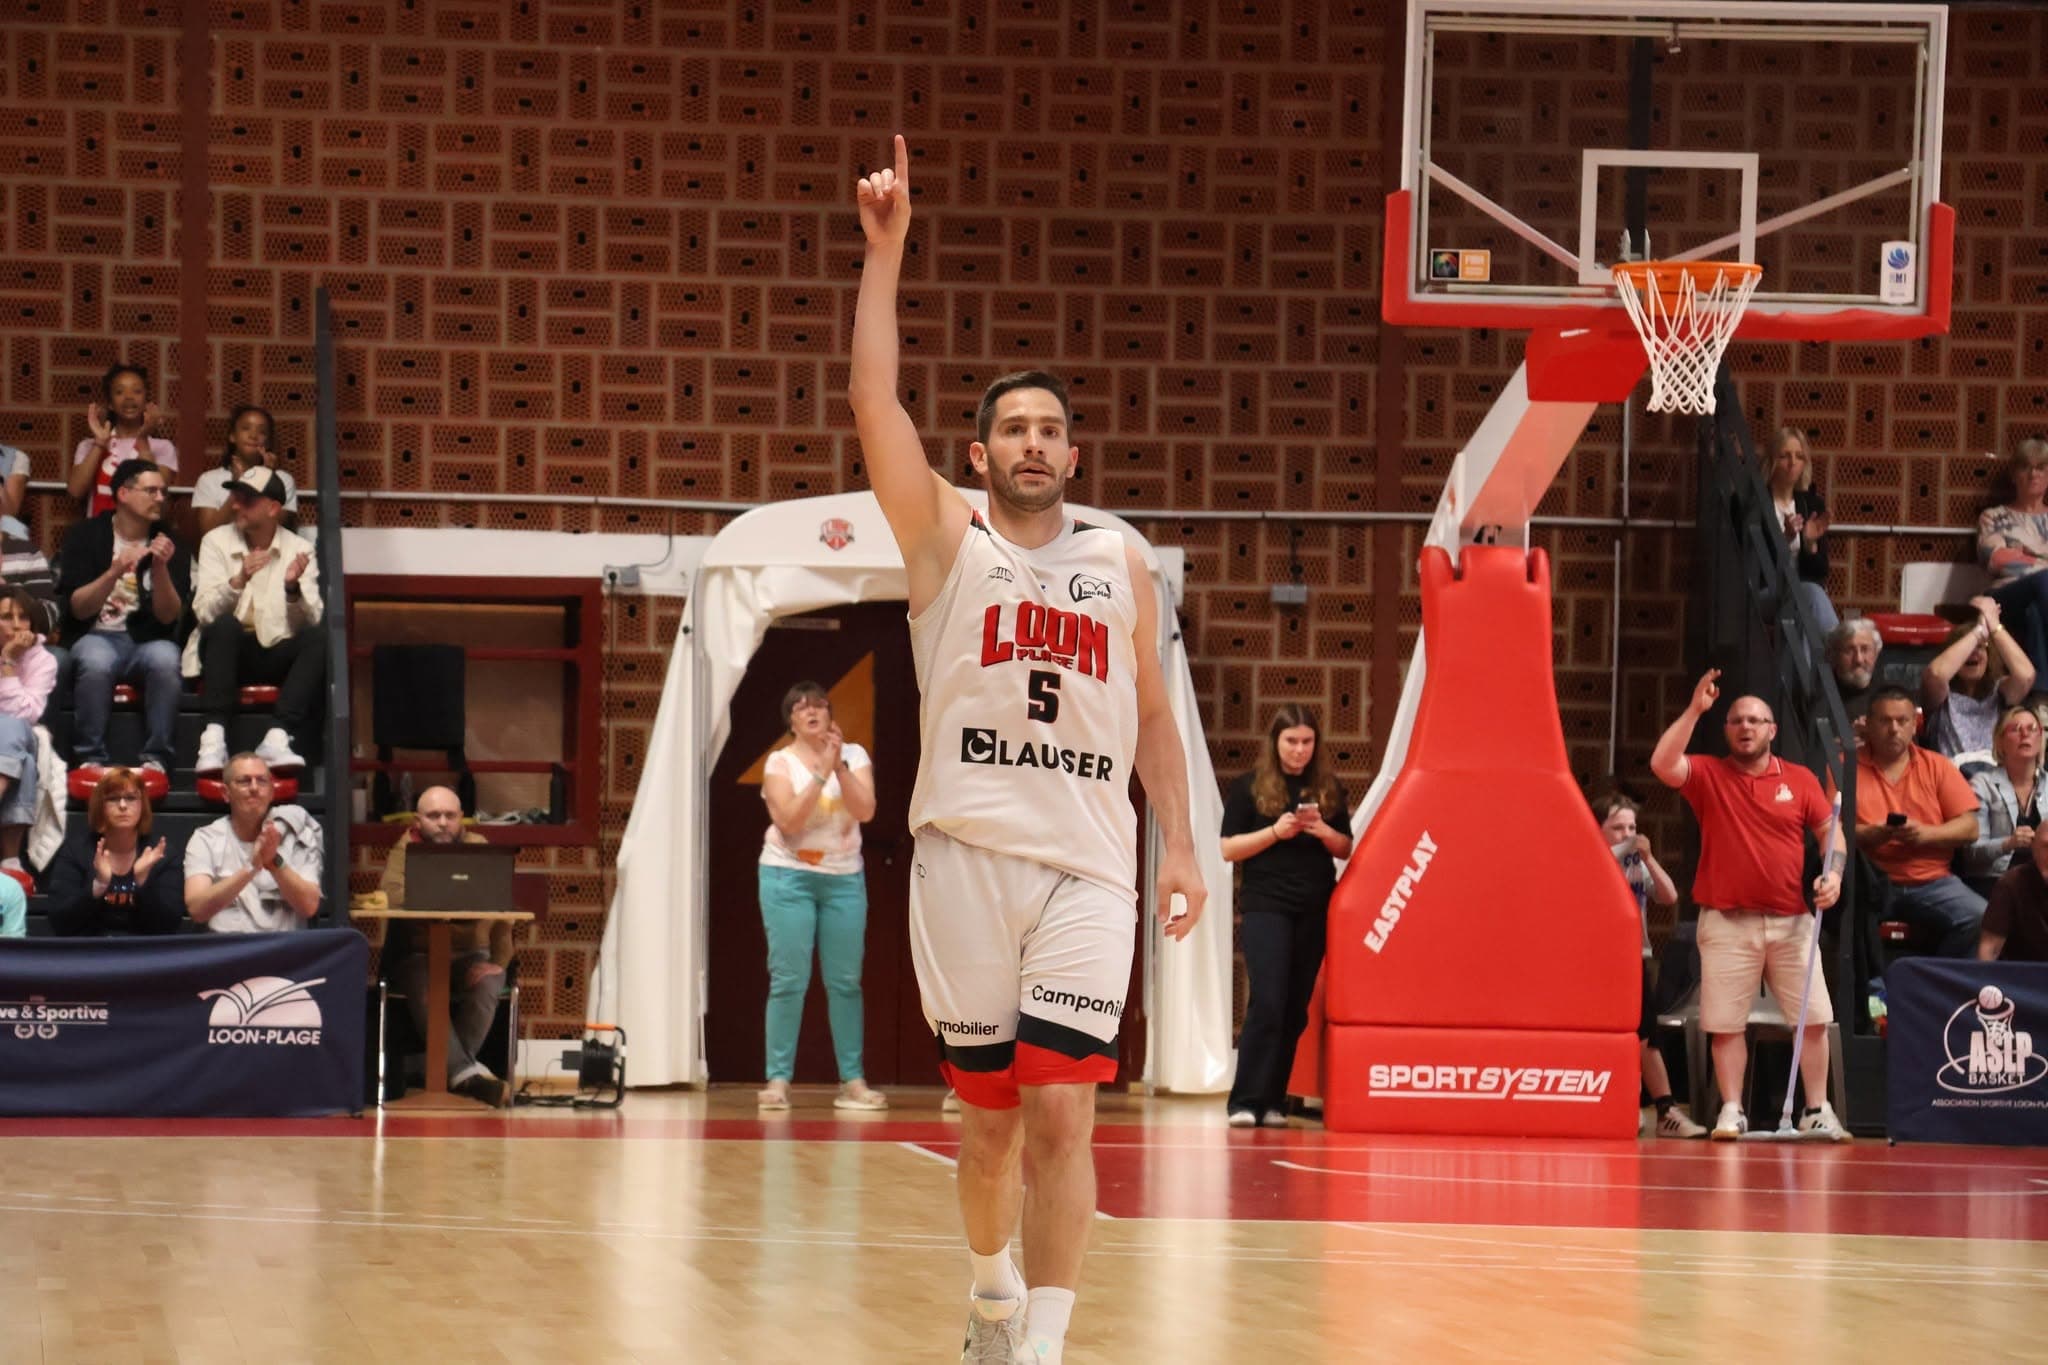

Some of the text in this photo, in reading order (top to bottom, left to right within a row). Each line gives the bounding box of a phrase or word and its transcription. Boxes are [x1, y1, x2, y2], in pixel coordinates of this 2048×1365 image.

[981, 600, 1108, 684] LOON
[1028, 669, 1061, 723] 5
[961, 728, 1113, 781] CLAUSER
[1363, 830, 1439, 954] EASYPLAY
[36, 1005, 108, 1023] Sportive
[935, 1019, 999, 1036] mobilier
[208, 1028, 321, 1045] LOON-PLAGE
[1969, 1031, 2032, 1075] ASLP
[1968, 1073, 2025, 1086] BASKET
